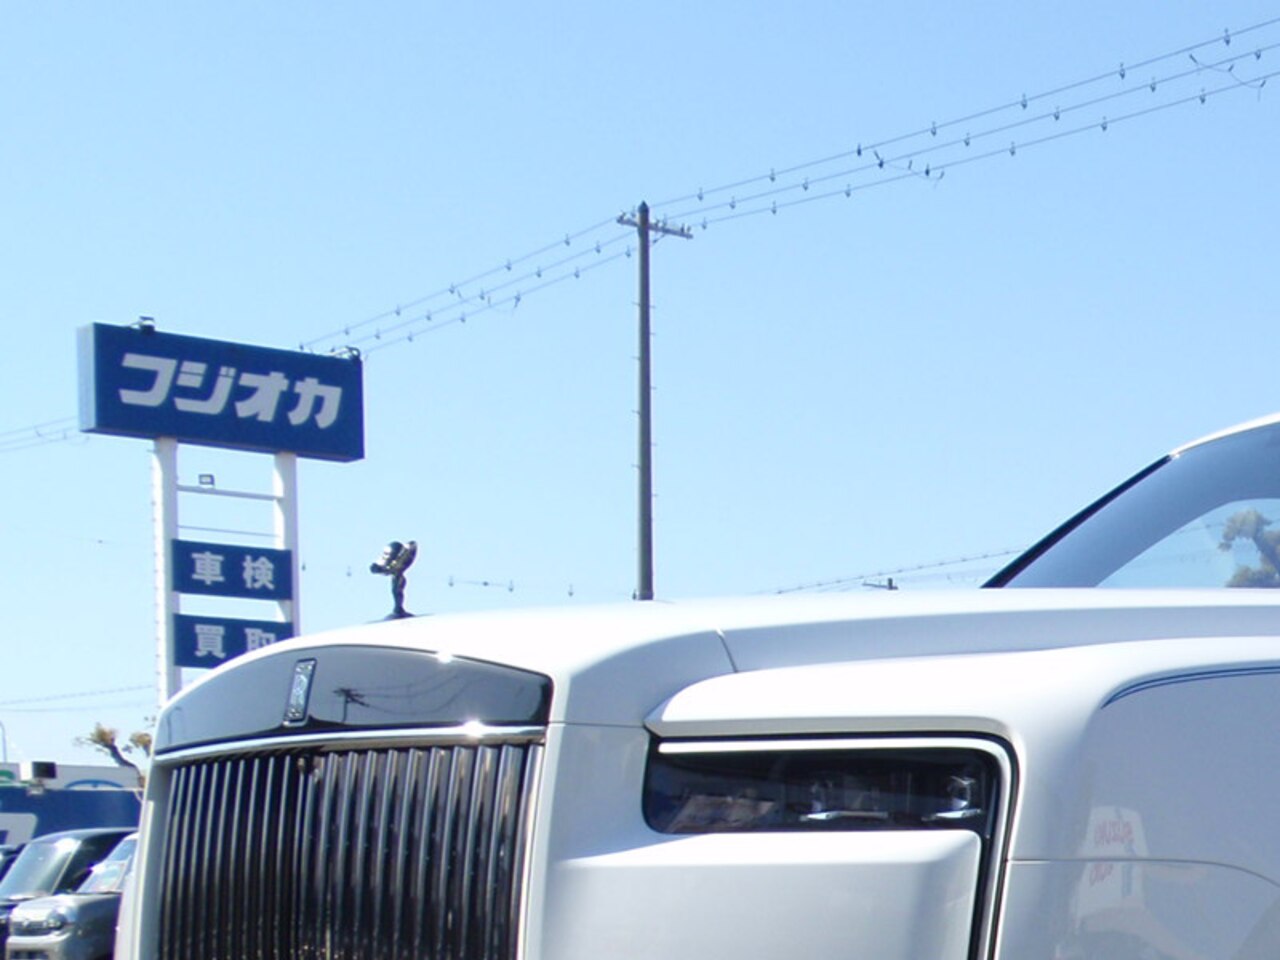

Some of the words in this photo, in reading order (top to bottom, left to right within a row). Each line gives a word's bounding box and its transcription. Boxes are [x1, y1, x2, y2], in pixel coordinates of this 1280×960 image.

[118, 352, 343, 430] フジオカ
[190, 551, 275, 590] 車検
